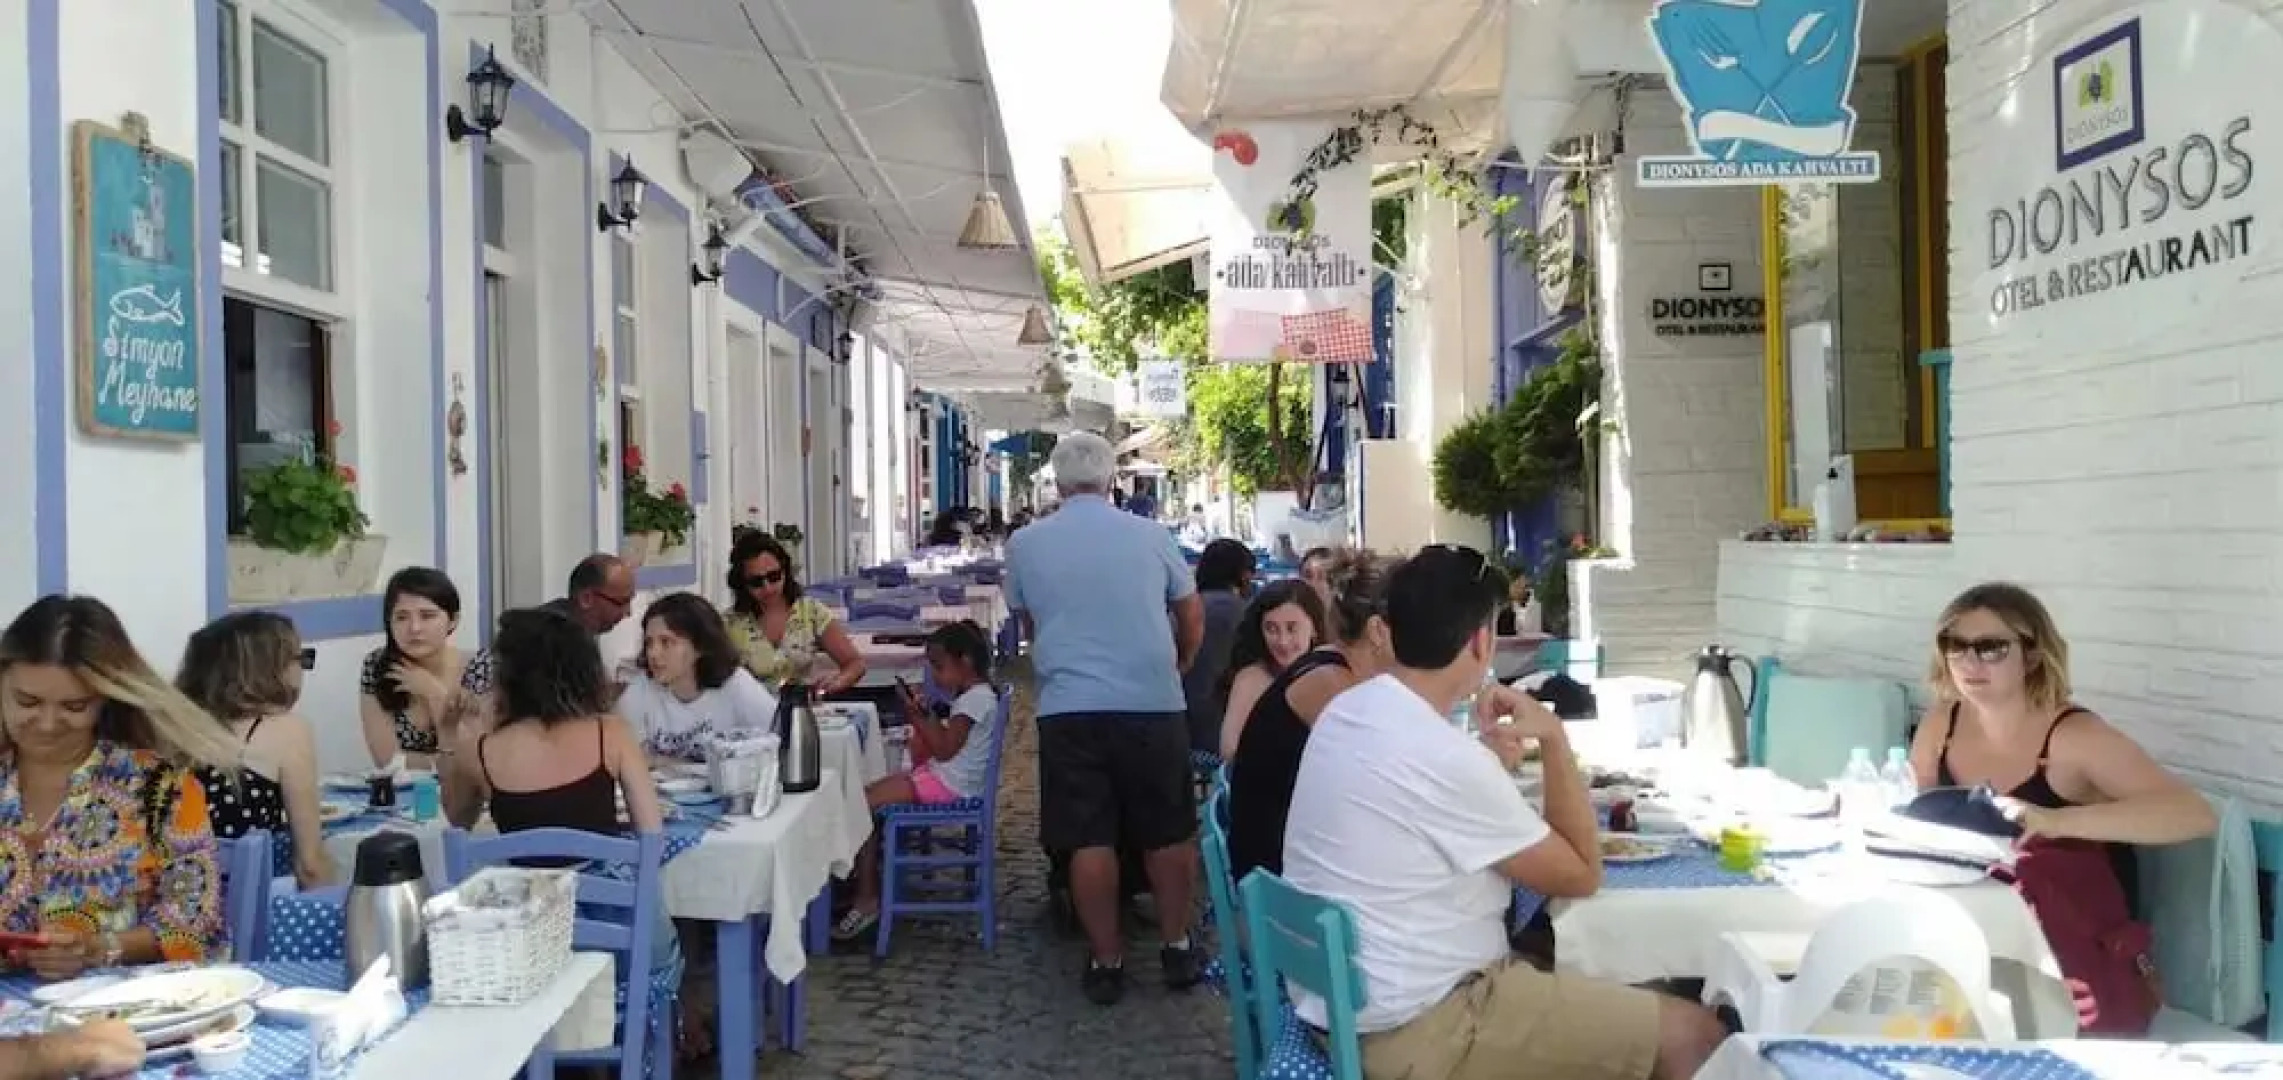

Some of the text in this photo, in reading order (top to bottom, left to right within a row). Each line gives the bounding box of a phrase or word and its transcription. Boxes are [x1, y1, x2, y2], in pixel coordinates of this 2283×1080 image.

[1650, 158, 1868, 178] DIONYSOS ADA KAHVALTI
[1988, 115, 2252, 270] DIONYSOS
[1991, 214, 2254, 318] OTEL & RESTAURANT
[1652, 297, 1766, 319] DIONYSO
[97, 358, 197, 425] Meyhane
